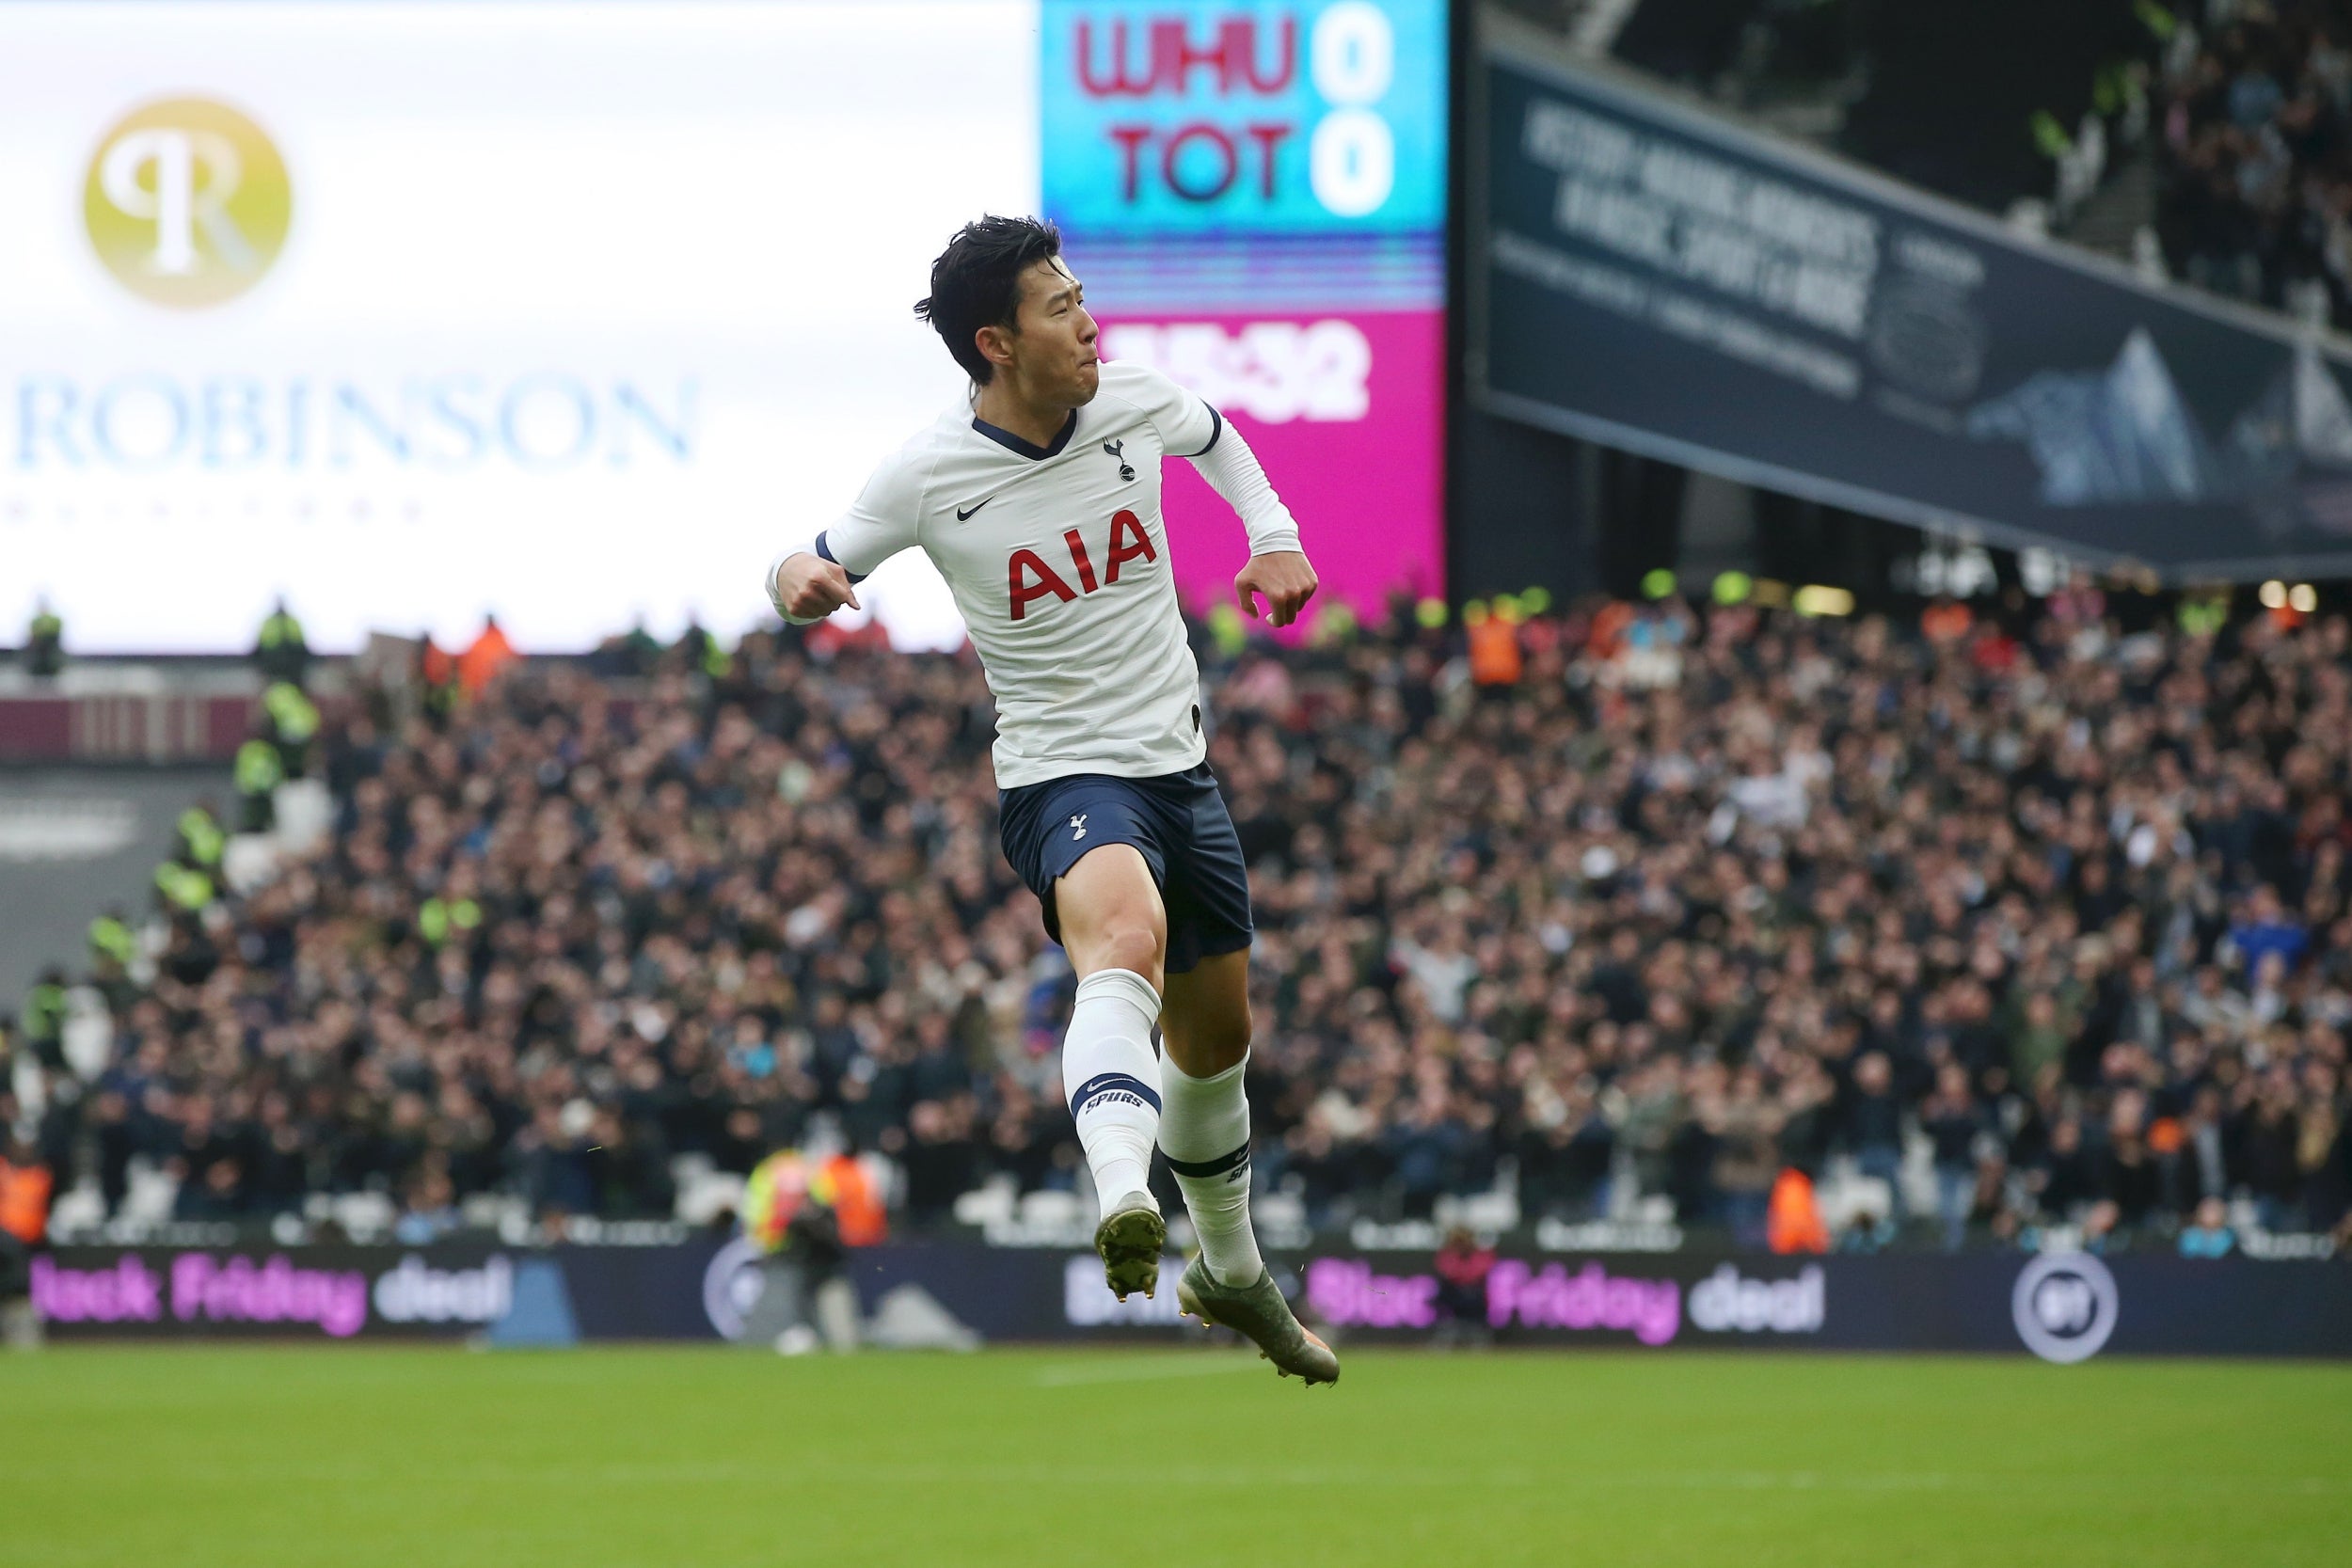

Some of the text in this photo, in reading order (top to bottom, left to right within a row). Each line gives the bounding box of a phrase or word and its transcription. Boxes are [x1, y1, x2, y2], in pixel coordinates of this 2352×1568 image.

[1074, 4, 1394, 105] WHU 0
[1108, 107, 1394, 217] TOT 0
[13, 369, 700, 476] ROBINSON
[1009, 509, 1157, 621] AIA
[1085, 1091, 1144, 1115] SPURS
[28, 1253, 512, 1338] lack Friday deal
[1308, 1259, 1439, 1326] Blac
[1486, 1259, 1681, 1345] Friday
[1689, 1262, 1825, 1332] deal
